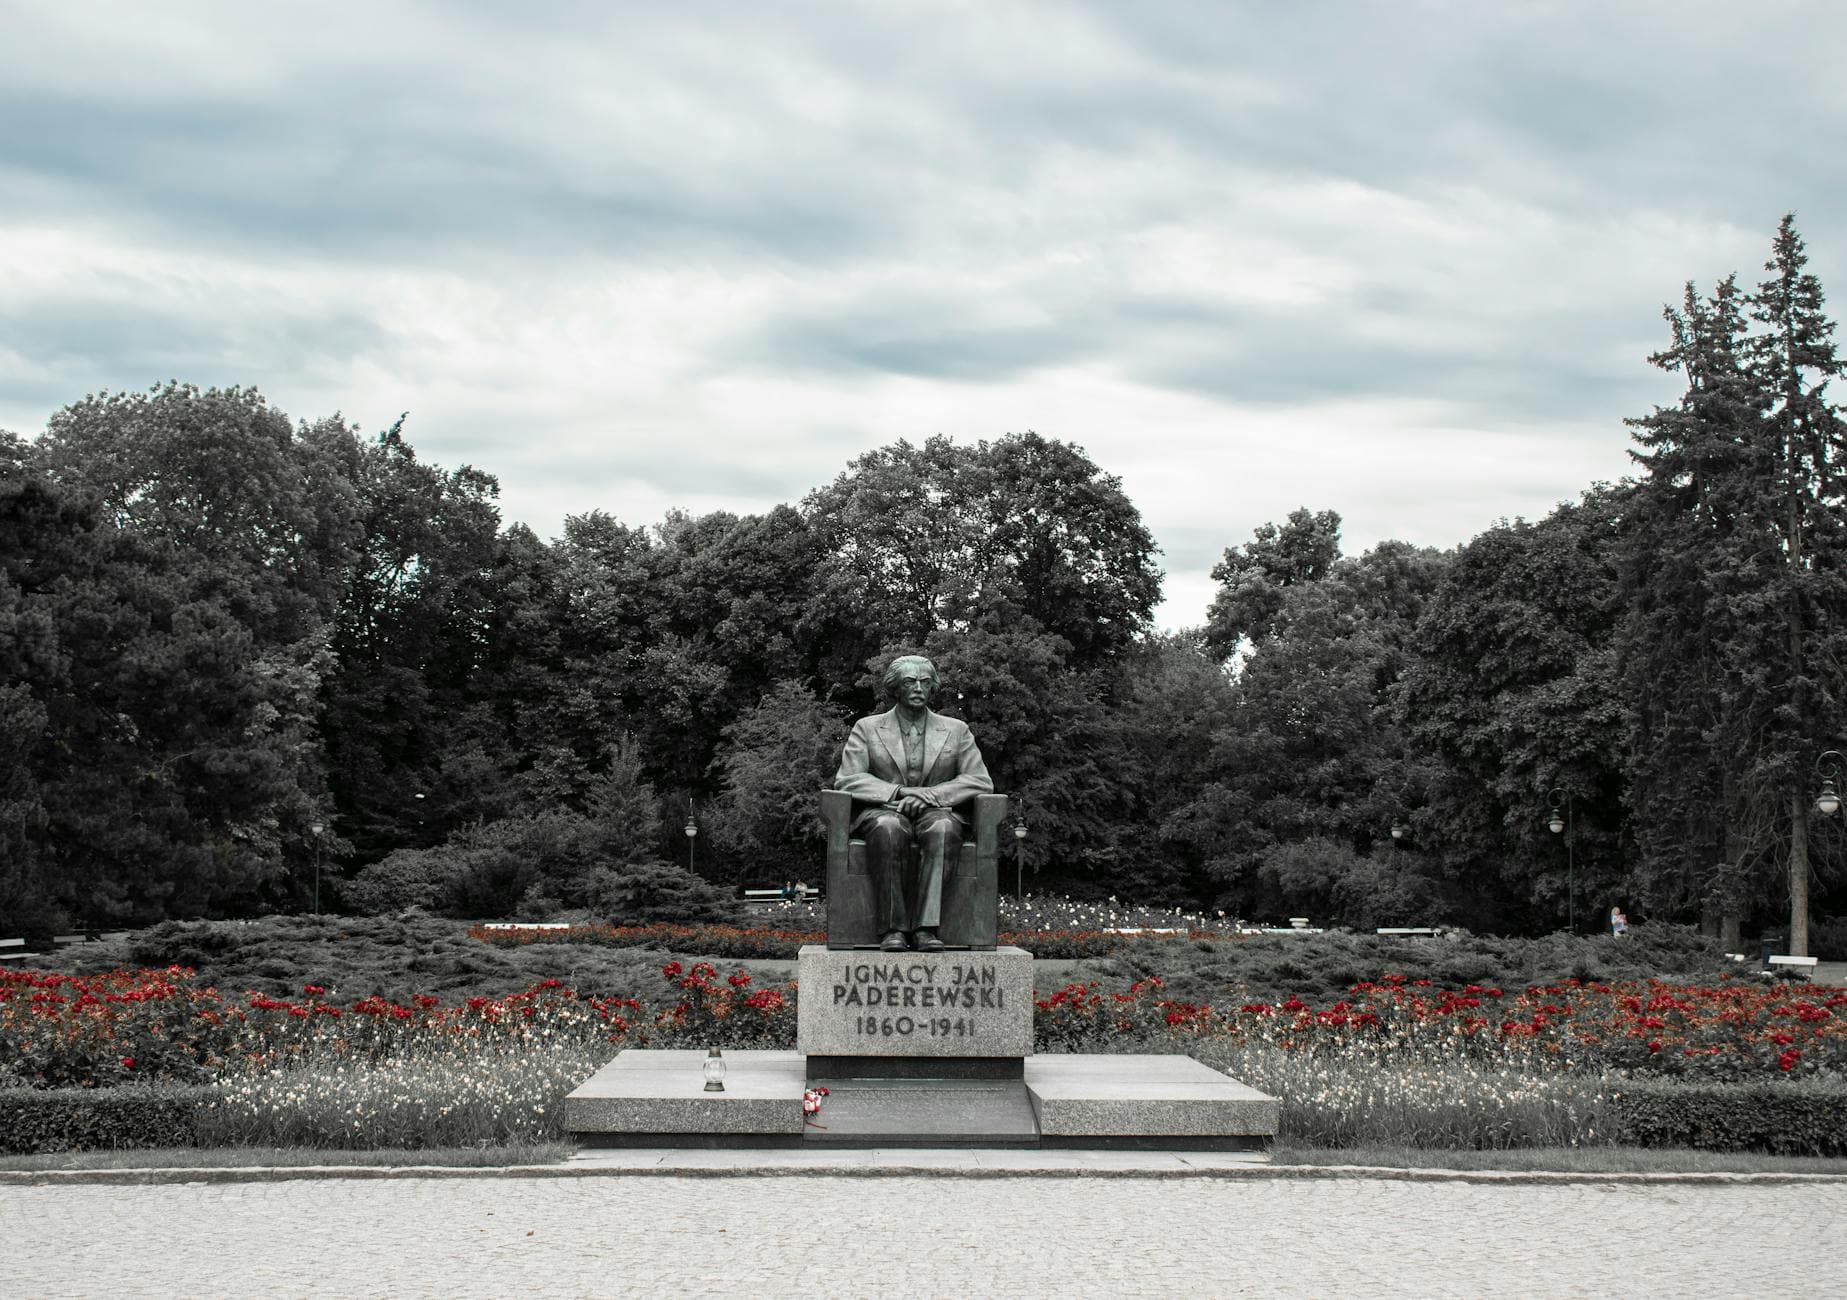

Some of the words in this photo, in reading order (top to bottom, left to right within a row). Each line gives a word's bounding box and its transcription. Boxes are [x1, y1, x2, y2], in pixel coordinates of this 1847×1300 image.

[844, 965, 937, 984] IGNACY
[952, 966, 996, 985] JAN
[833, 985, 1004, 1008] PADEREWSKI
[857, 1016, 975, 1036] 1860-1941
